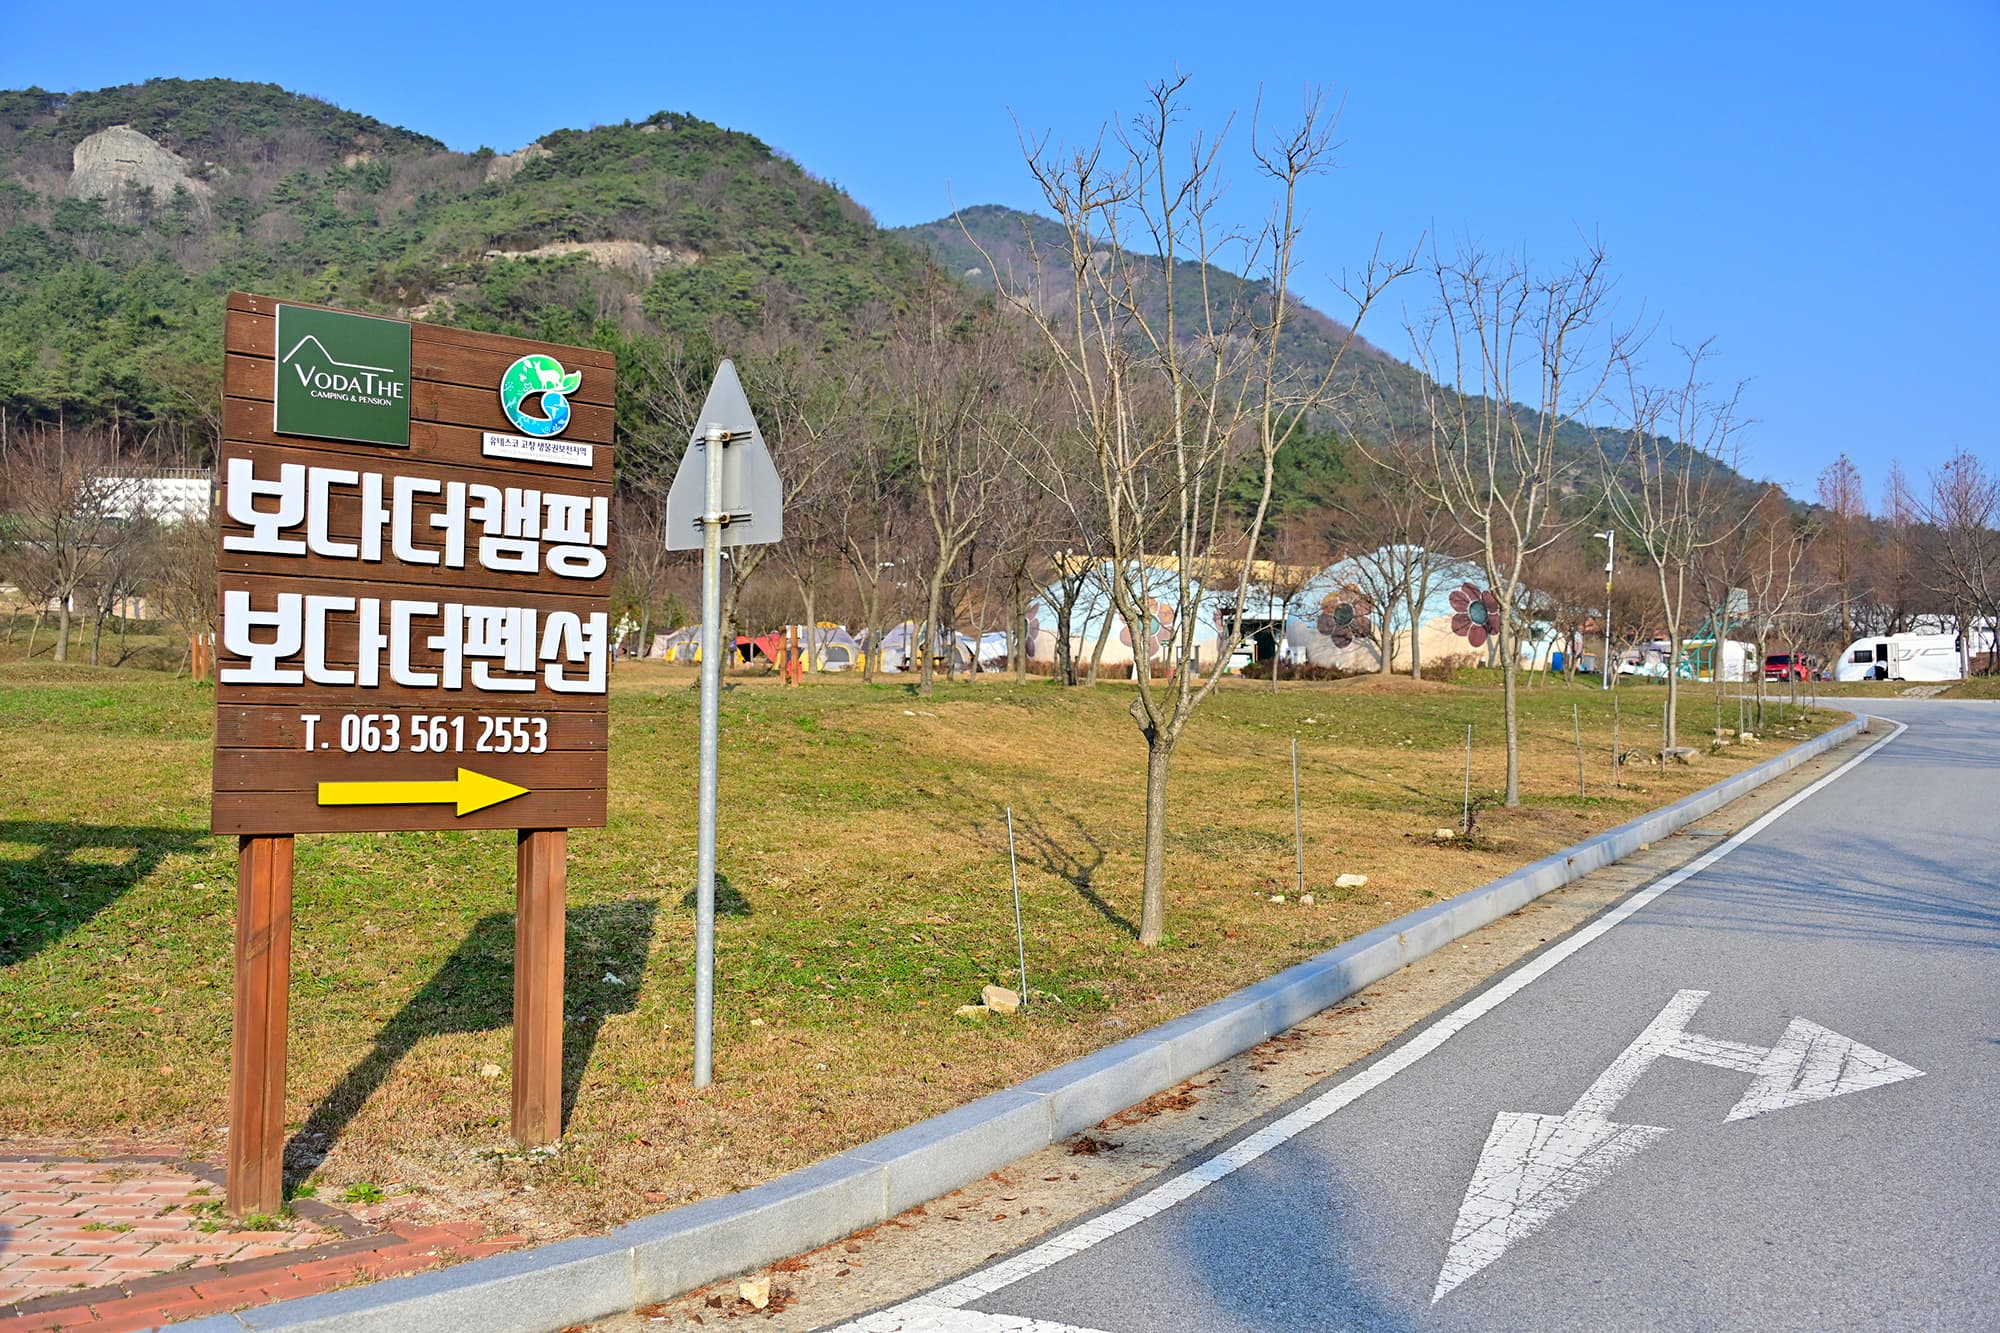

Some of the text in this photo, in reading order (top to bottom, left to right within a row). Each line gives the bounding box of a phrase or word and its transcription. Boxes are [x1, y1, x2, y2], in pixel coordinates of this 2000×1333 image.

[310, 390, 349, 401] CAMPING
[359, 396, 392, 406] PENSION
[223, 458, 608, 578] 보다더캠핑
[220, 590, 609, 694] 보다더펜션
[300, 714, 549, 754] T. 063 561 2553
